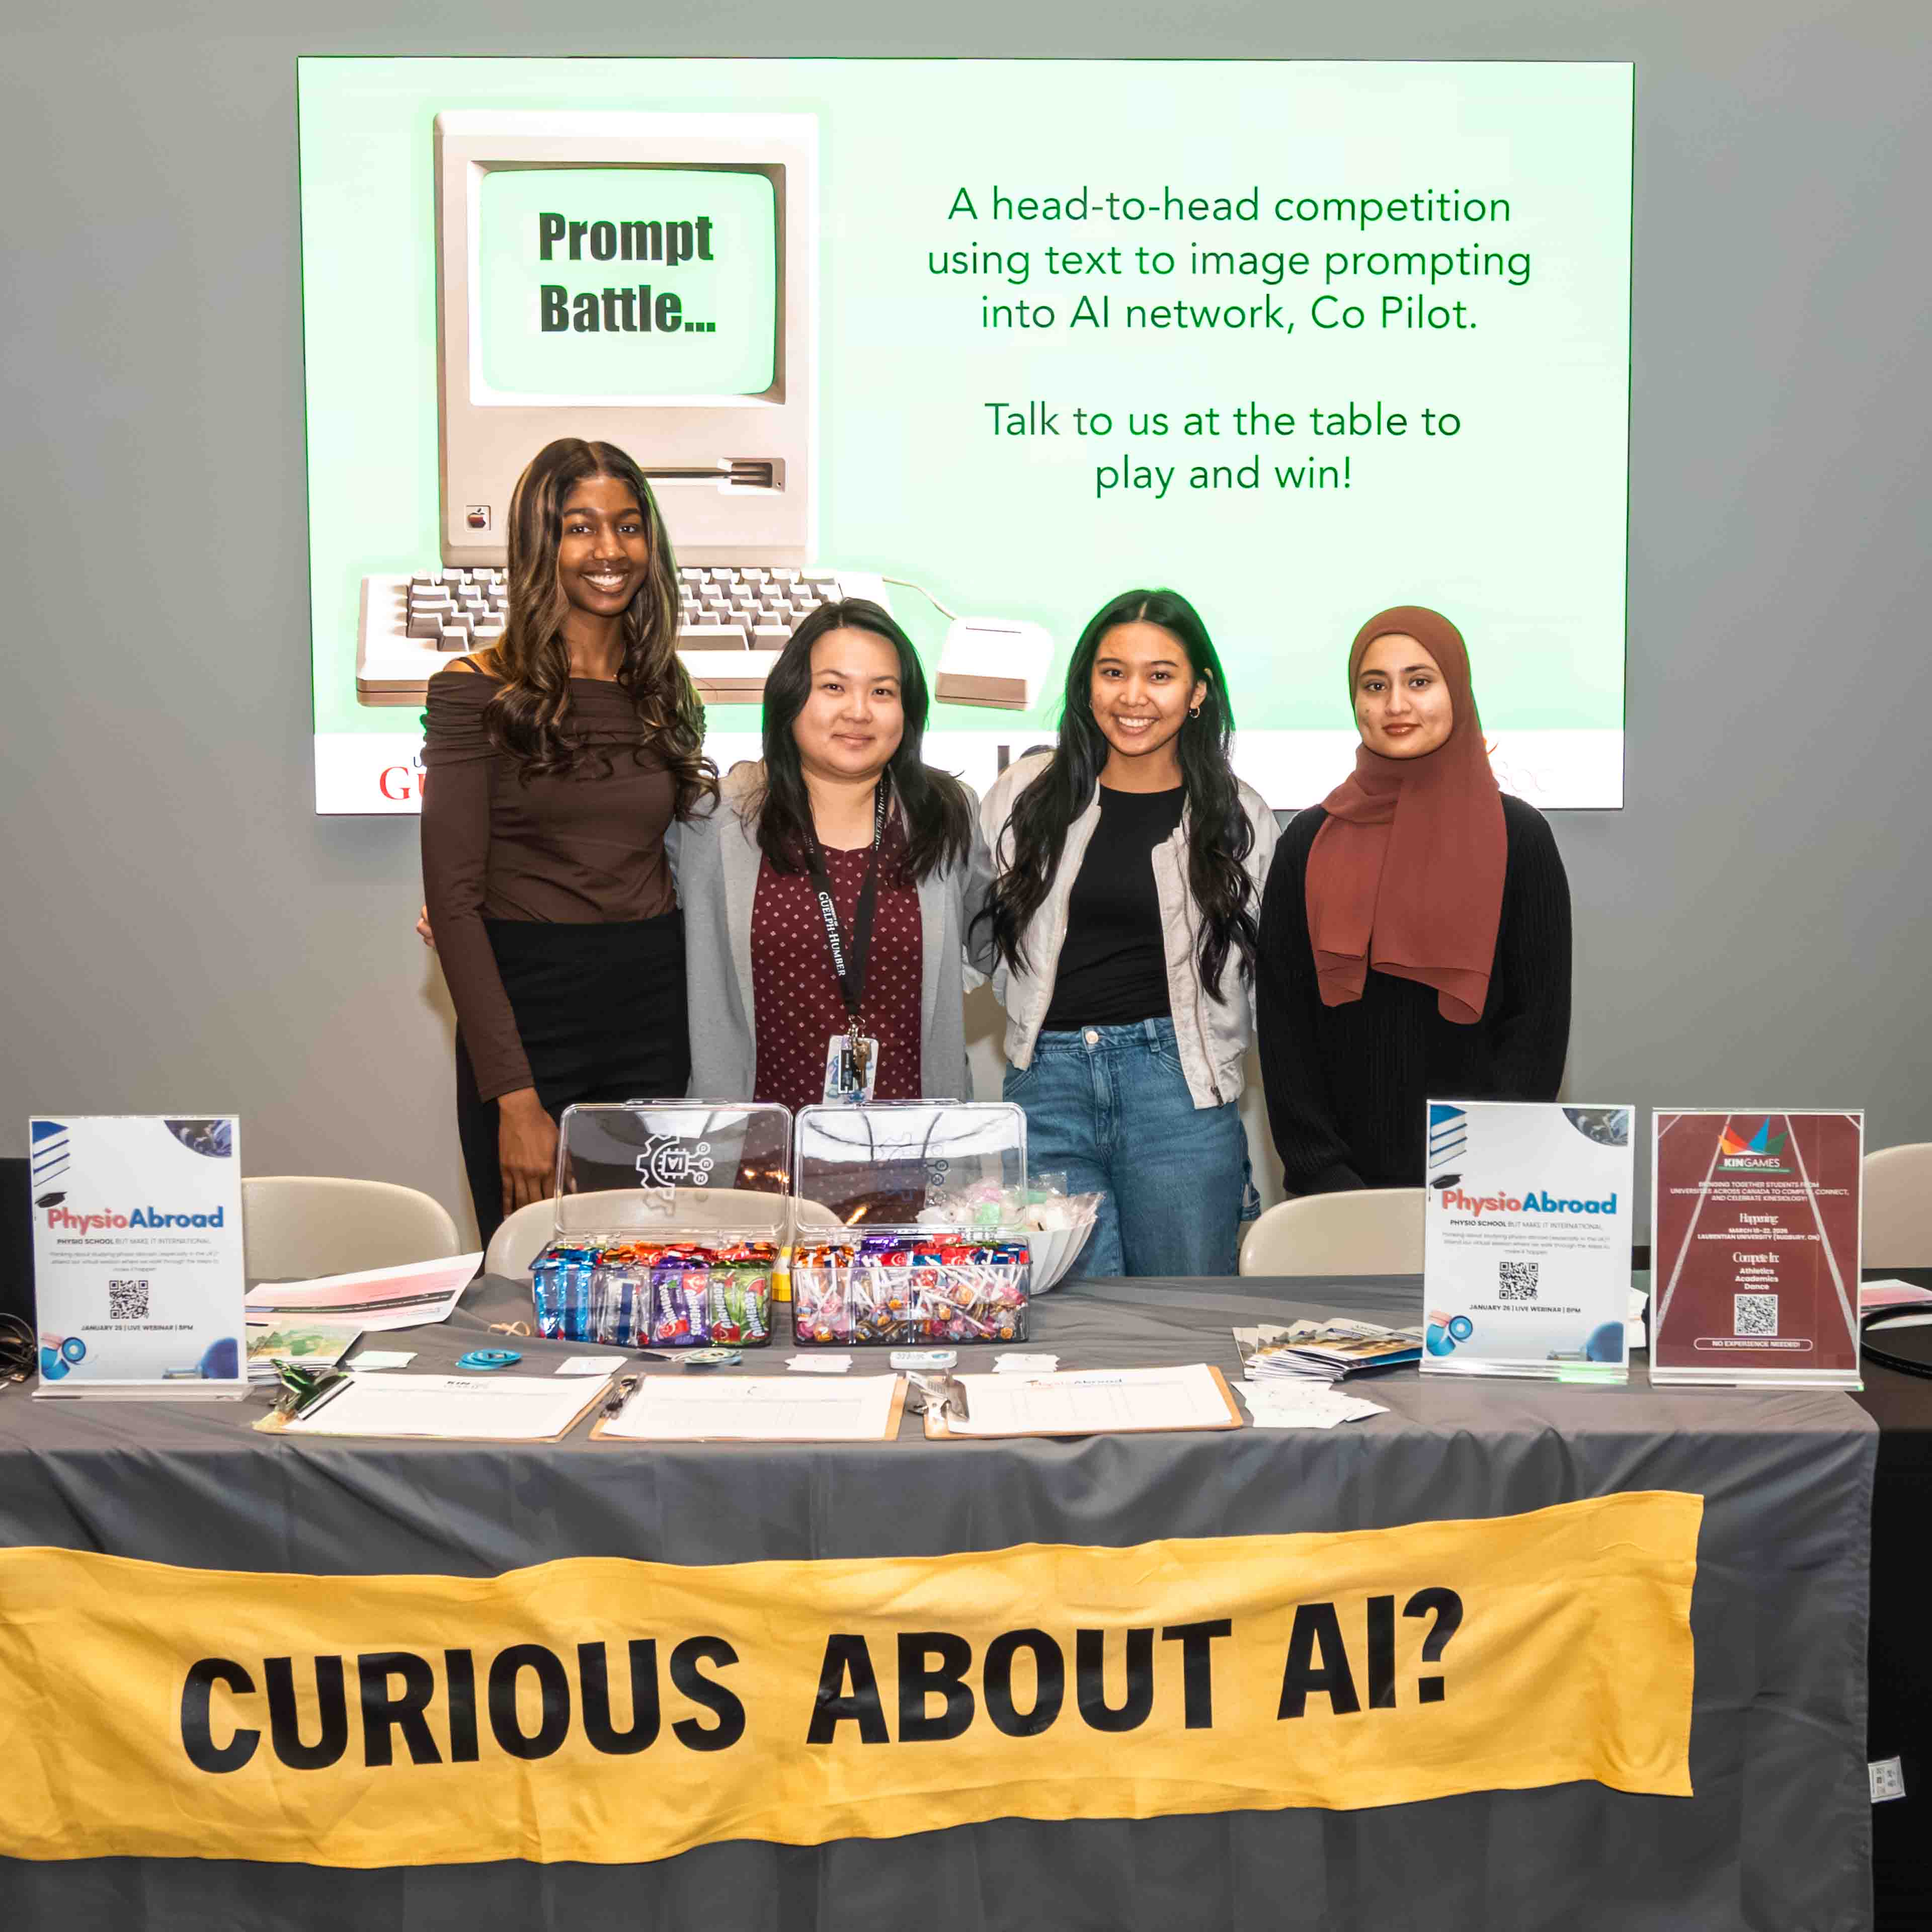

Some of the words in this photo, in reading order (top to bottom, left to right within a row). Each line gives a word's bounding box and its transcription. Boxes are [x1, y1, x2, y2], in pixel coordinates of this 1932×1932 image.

[948, 187, 978, 219] A
[994, 185, 1258, 221] head-to-head
[1275, 189, 1511, 231] competition
[539, 212, 714, 266] Prompt
[929, 242, 1029, 285] using
[1044, 247, 1122, 275] text
[1135, 247, 1175, 275] to
[1191, 242, 1309, 285] image
[1326, 243, 1531, 286] prompting
[540, 284, 716, 333] Battle...
[983, 295, 1055, 329] into
[1070, 295, 1108, 328] AI
[1127, 294, 1294, 334] network,
[1312, 295, 1364, 329] Co
[1382, 294, 1476, 330] Pilot.
[985, 400, 1060, 436] Talk
[1073, 408, 1112, 436] to
[1130, 413, 1168, 436] us
[1184, 408, 1220, 436] at
[1233, 401, 1295, 436] the
[1309, 401, 1407, 436] table
[1421, 409, 1461, 436] to
[1097, 454, 1175, 499] play
[1190, 454, 1259, 489] and
[1274, 455, 1351, 489] win!
[819, 892, 846, 976] GUELPH-HUMBER
[1724, 1158, 1780, 1168] KINGAMES
[48, 1205, 224, 1236] PhysioAbroad
[1441, 1188, 1617, 1217] PhysioAbroad
[1550, 1223, 1602, 1231] INTERNATIONAL
[181, 1636, 746, 1774] CURIOUS
[806, 1619, 1232, 1744] ABOUT
[1277, 1587, 1464, 1720] AI?
